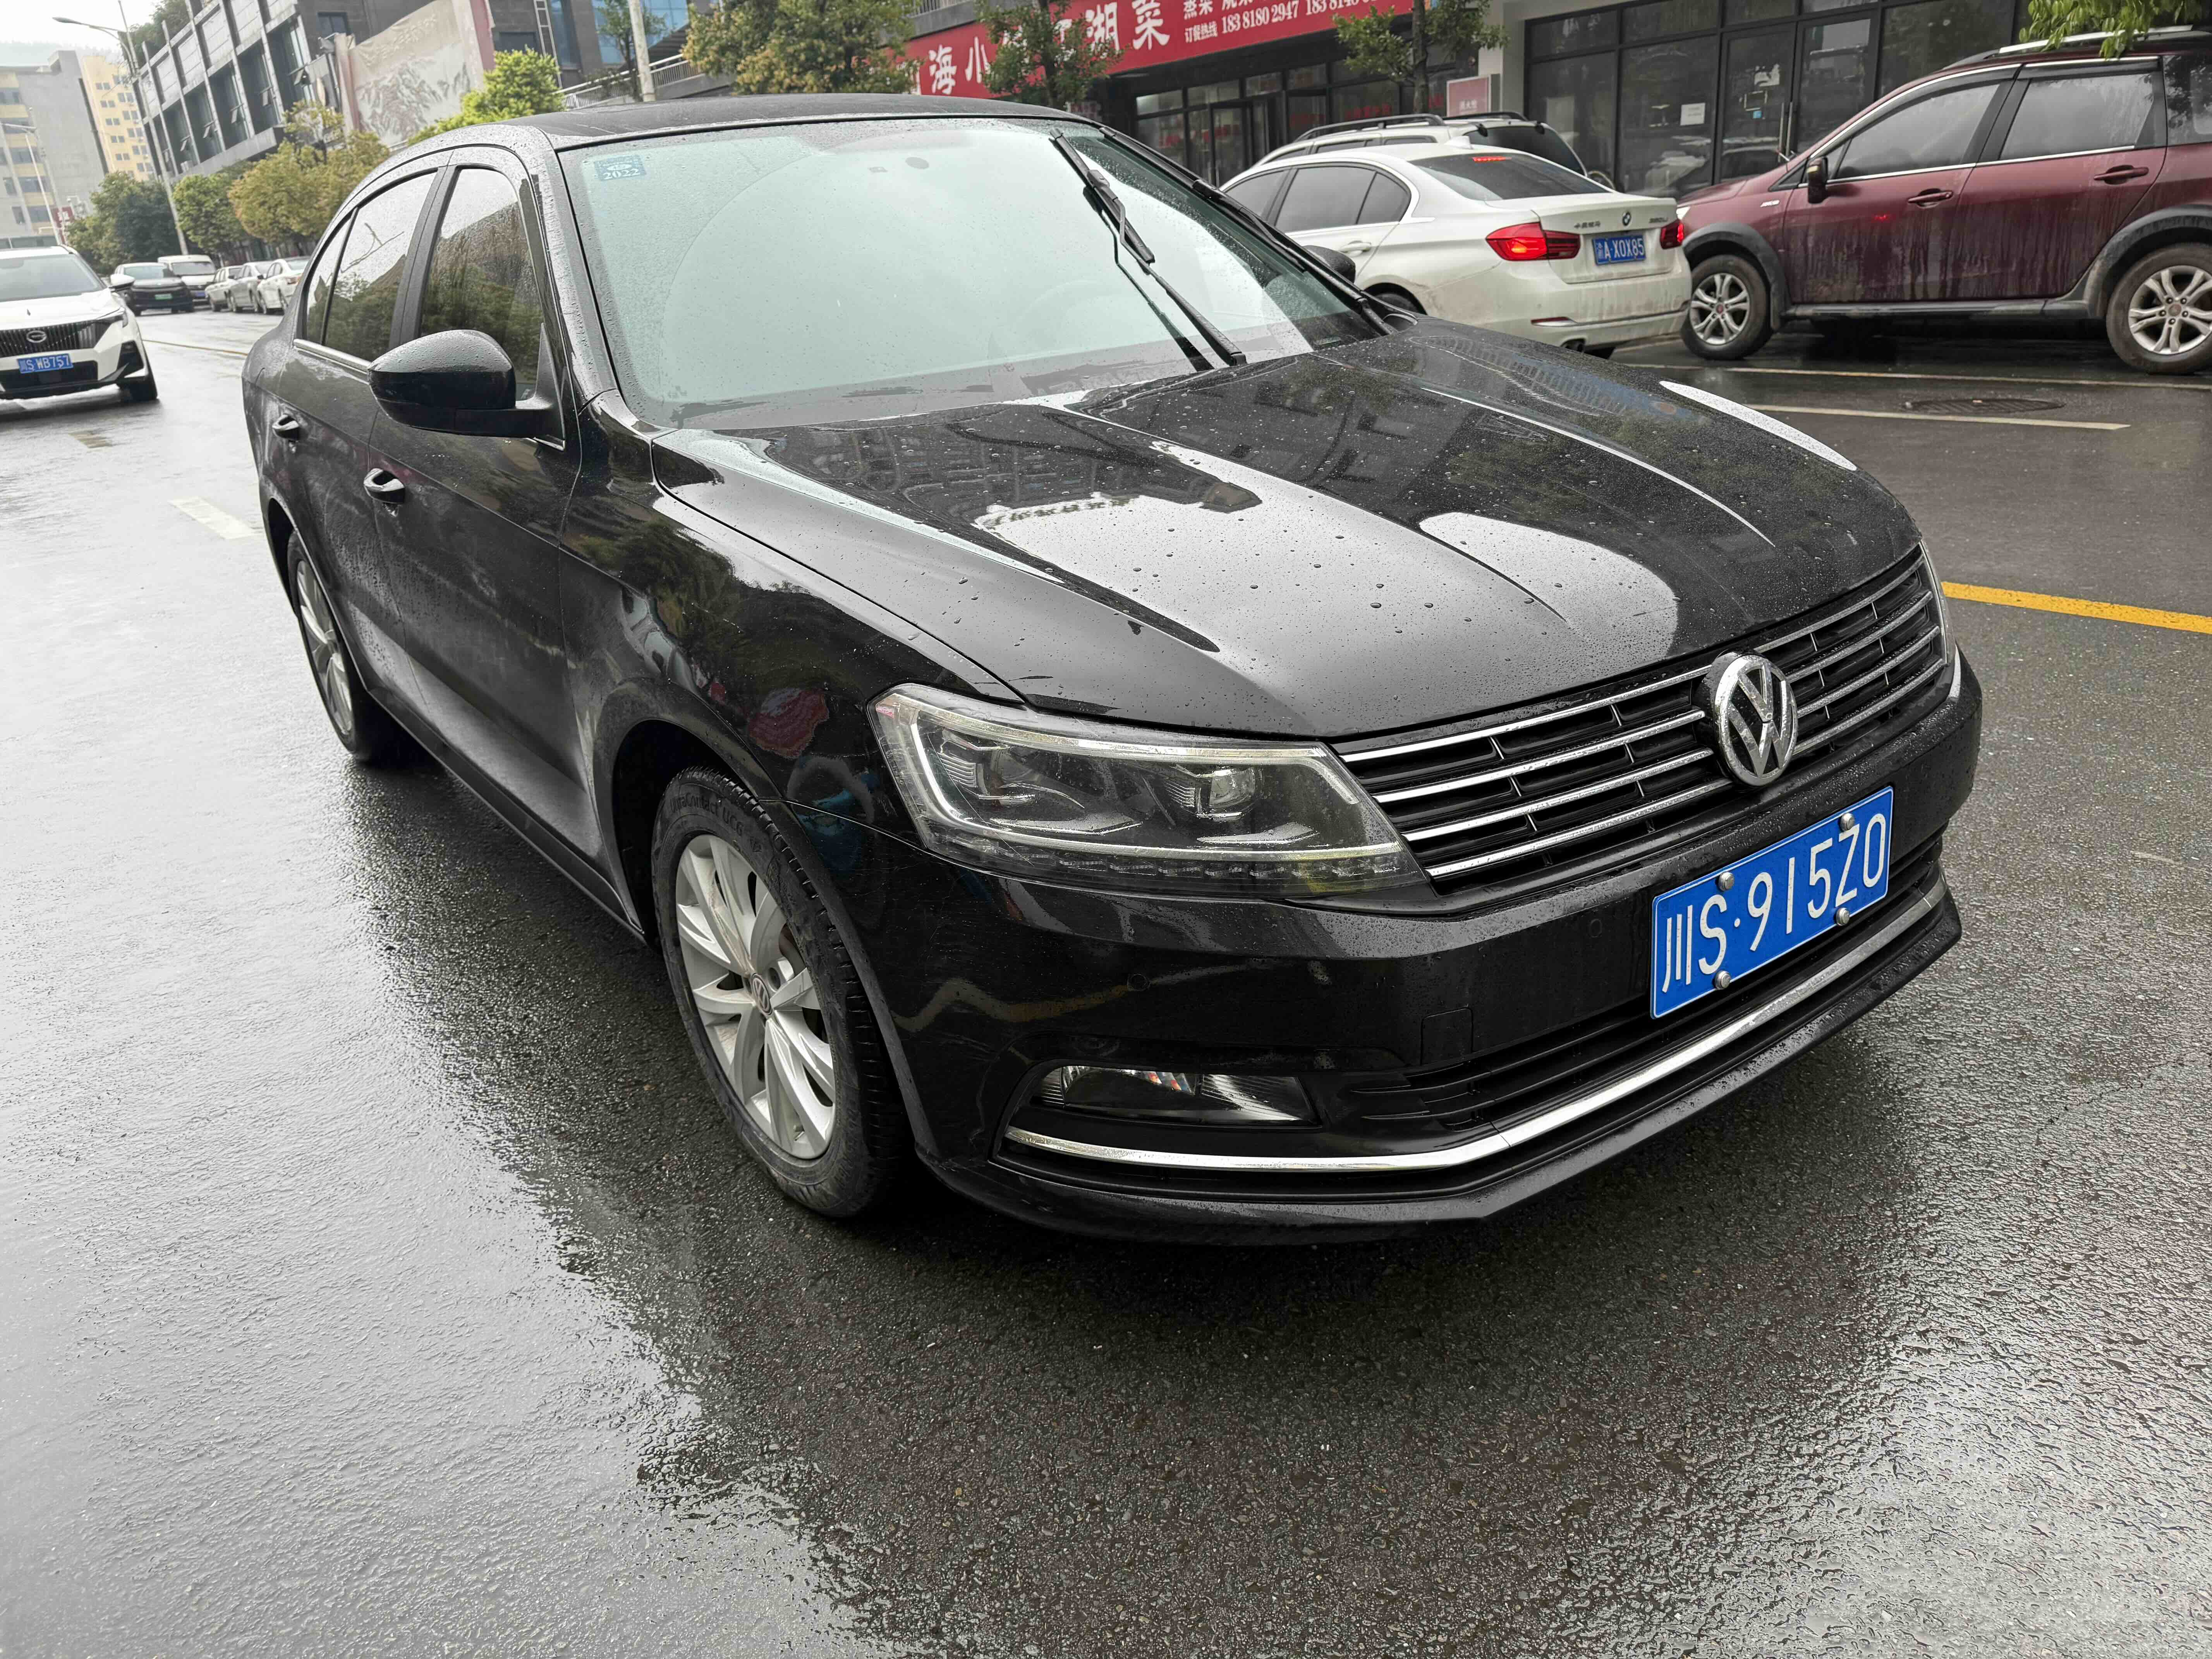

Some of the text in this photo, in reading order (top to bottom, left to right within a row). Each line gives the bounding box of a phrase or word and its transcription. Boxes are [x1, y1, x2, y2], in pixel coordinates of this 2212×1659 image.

[1185, 21, 1218, 43] 订餐热线
[1222, 13, 1240, 34] 183
[1243, 7, 1269, 29] 8180
[1271, 0, 1299, 22] 2947
[1306, 0, 1327, 15] 183
[603, 168, 641, 180] 2022
